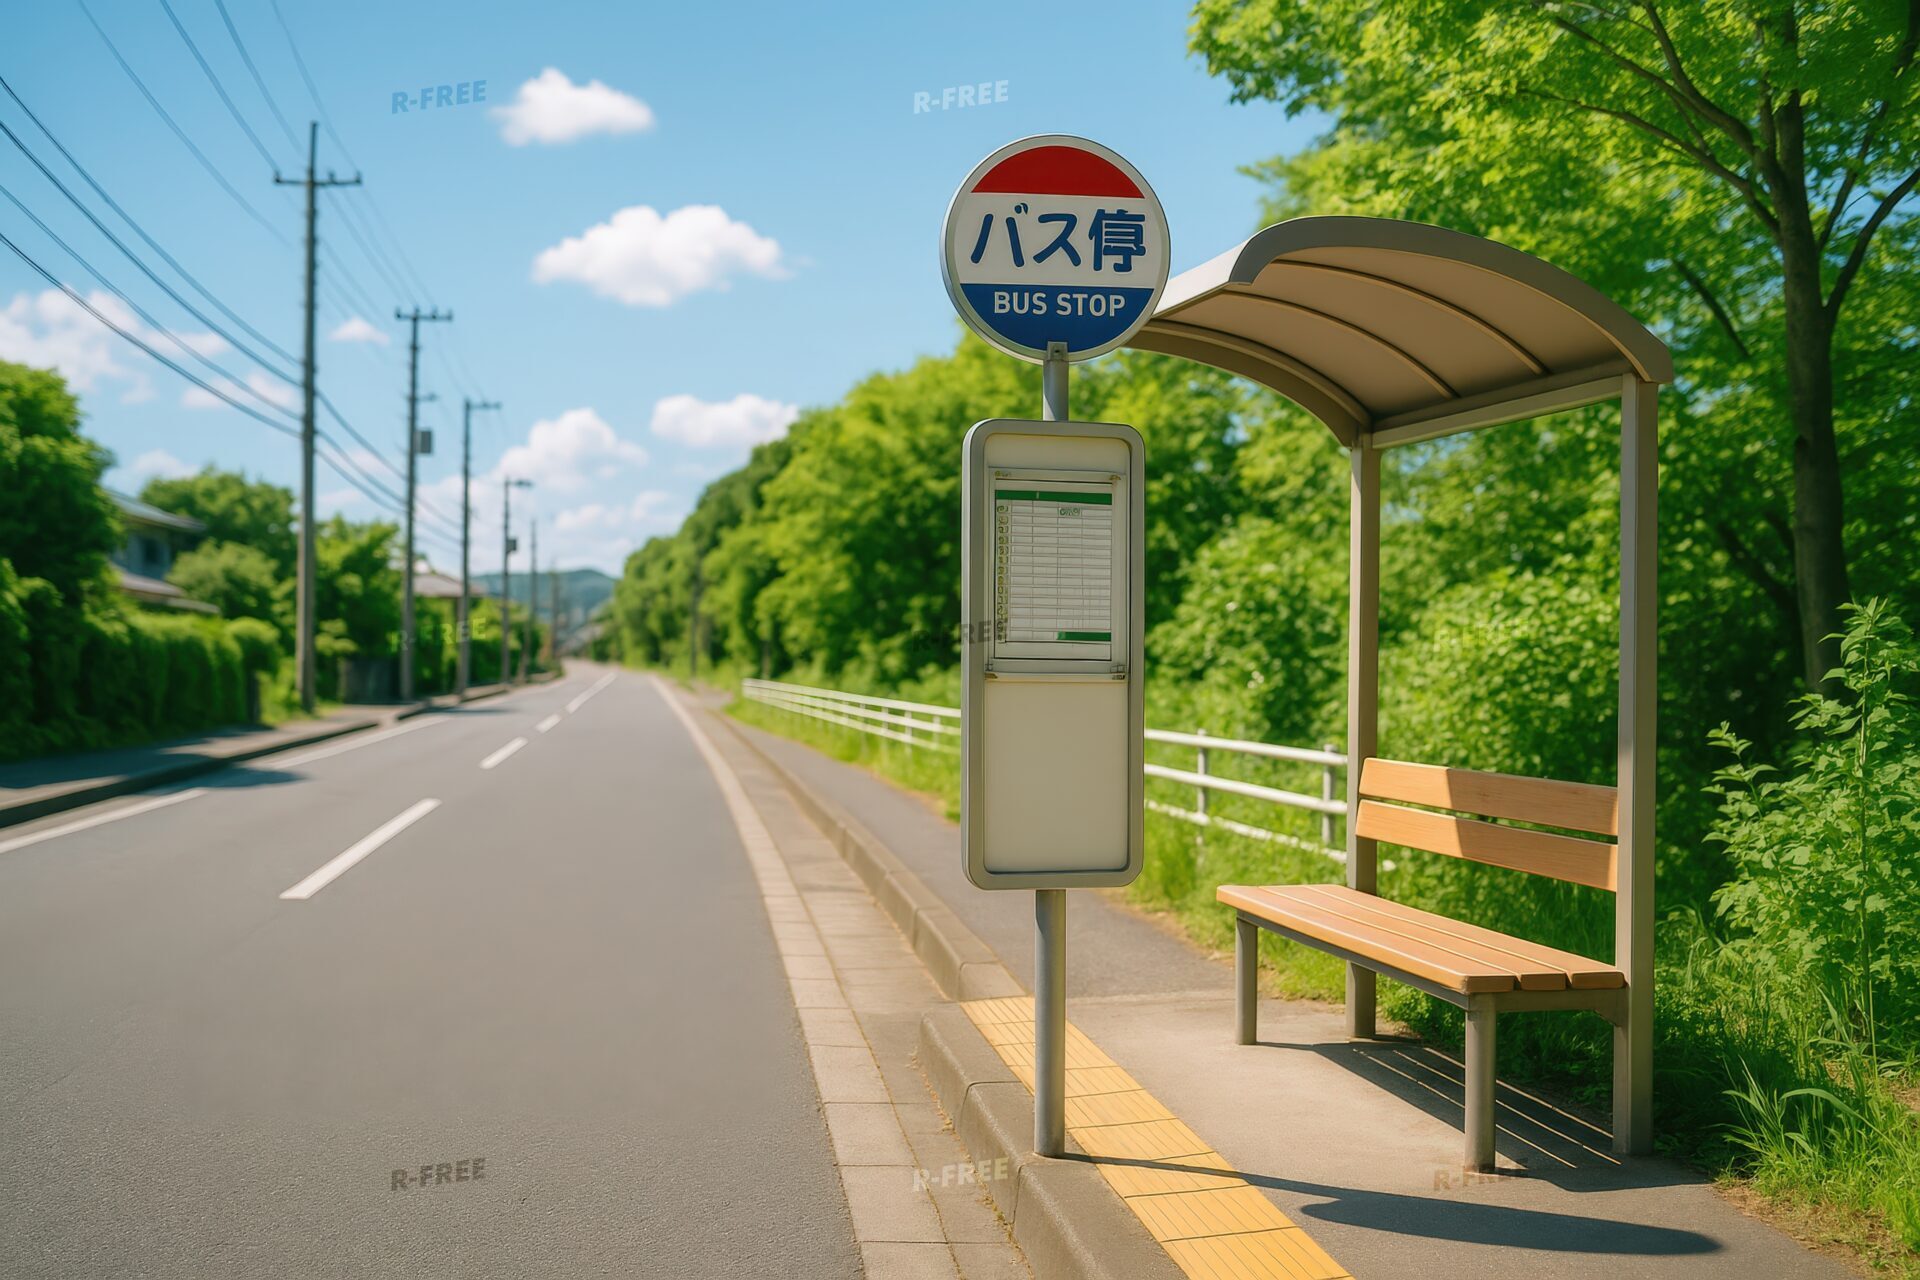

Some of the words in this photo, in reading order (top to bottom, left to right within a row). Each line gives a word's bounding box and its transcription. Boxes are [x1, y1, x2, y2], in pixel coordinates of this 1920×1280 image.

[971, 203, 1146, 272] バス停
[994, 291, 1047, 314] BUS
[1056, 294, 1126, 317] STOP
